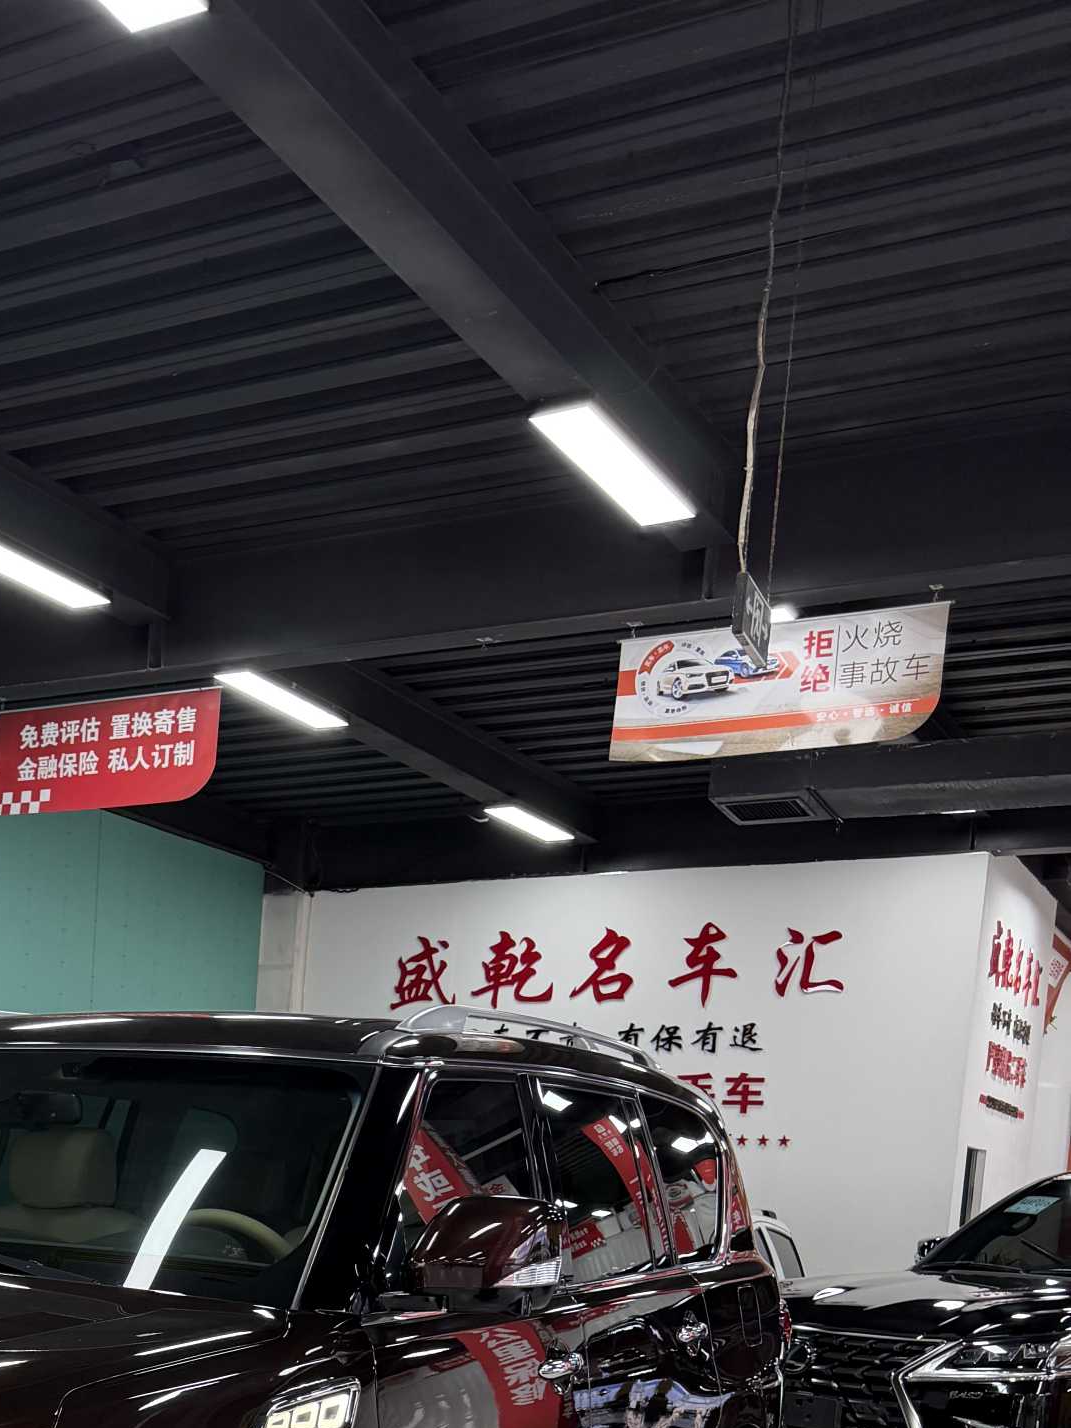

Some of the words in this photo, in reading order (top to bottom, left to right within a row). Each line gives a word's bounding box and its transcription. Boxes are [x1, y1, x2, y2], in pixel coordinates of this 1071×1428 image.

[842, 620, 904, 653] 火烧
[799, 629, 835, 694] 拒绝
[838, 653, 932, 690] 事故车
[19, 717, 102, 750] 免费评估
[108, 706, 198, 741] 置换寄售
[16, 750, 100, 782] 金融保险
[107, 740, 196, 773] 私人订制
[389, 921, 845, 1010] 盛乾名车汇
[618, 1021, 765, 1053] 有保有退
